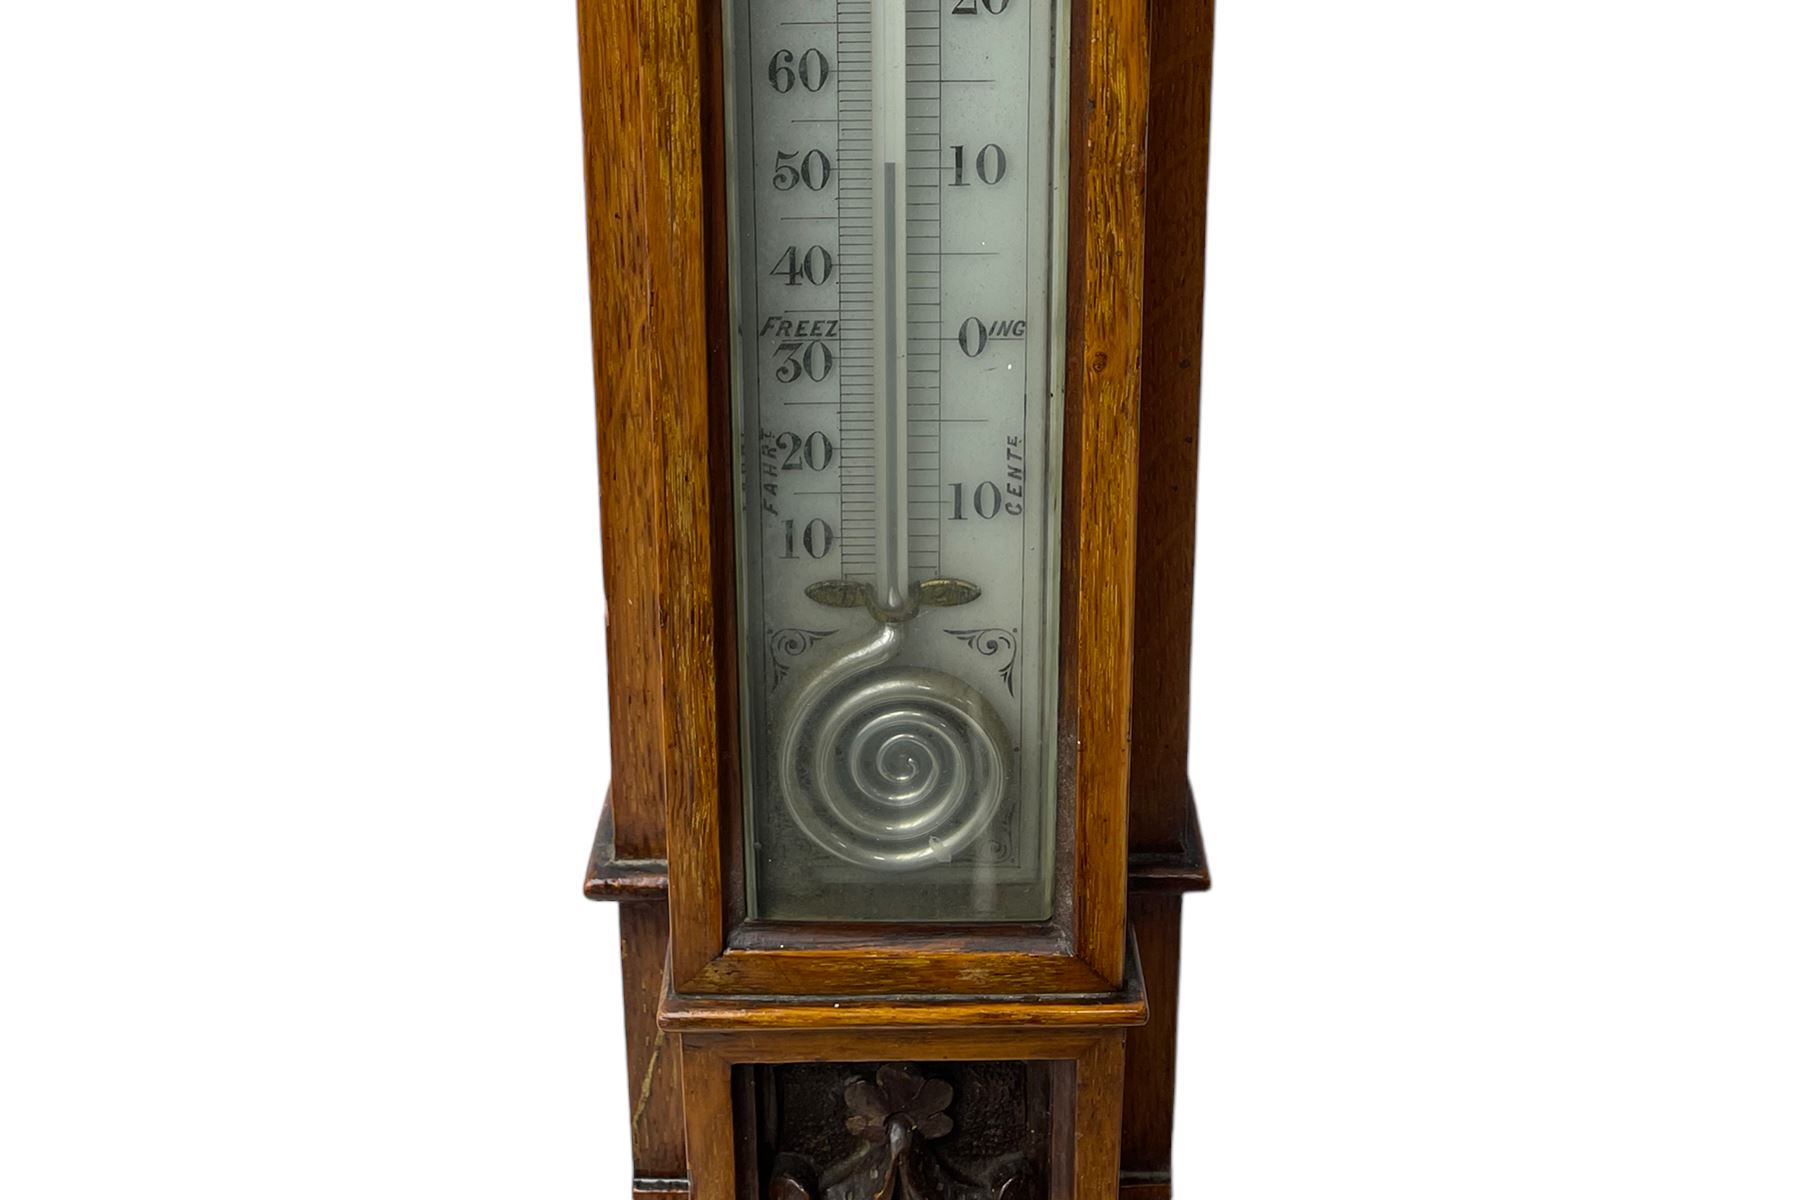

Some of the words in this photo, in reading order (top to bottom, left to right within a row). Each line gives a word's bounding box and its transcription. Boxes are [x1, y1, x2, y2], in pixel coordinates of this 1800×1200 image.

[768, 48, 830, 94] 60
[772, 149, 831, 191] 50
[948, 143, 1007, 186] 10
[769, 245, 833, 286] 40
[759, 316, 839, 337] FREEZ
[988, 320, 1026, 337] ING
[958, 316, 987, 358] 0
[773, 340, 833, 383] 30
[775, 431, 833, 471] 20
[948, 481, 1002, 520] 10
[779, 518, 834, 559] 10
